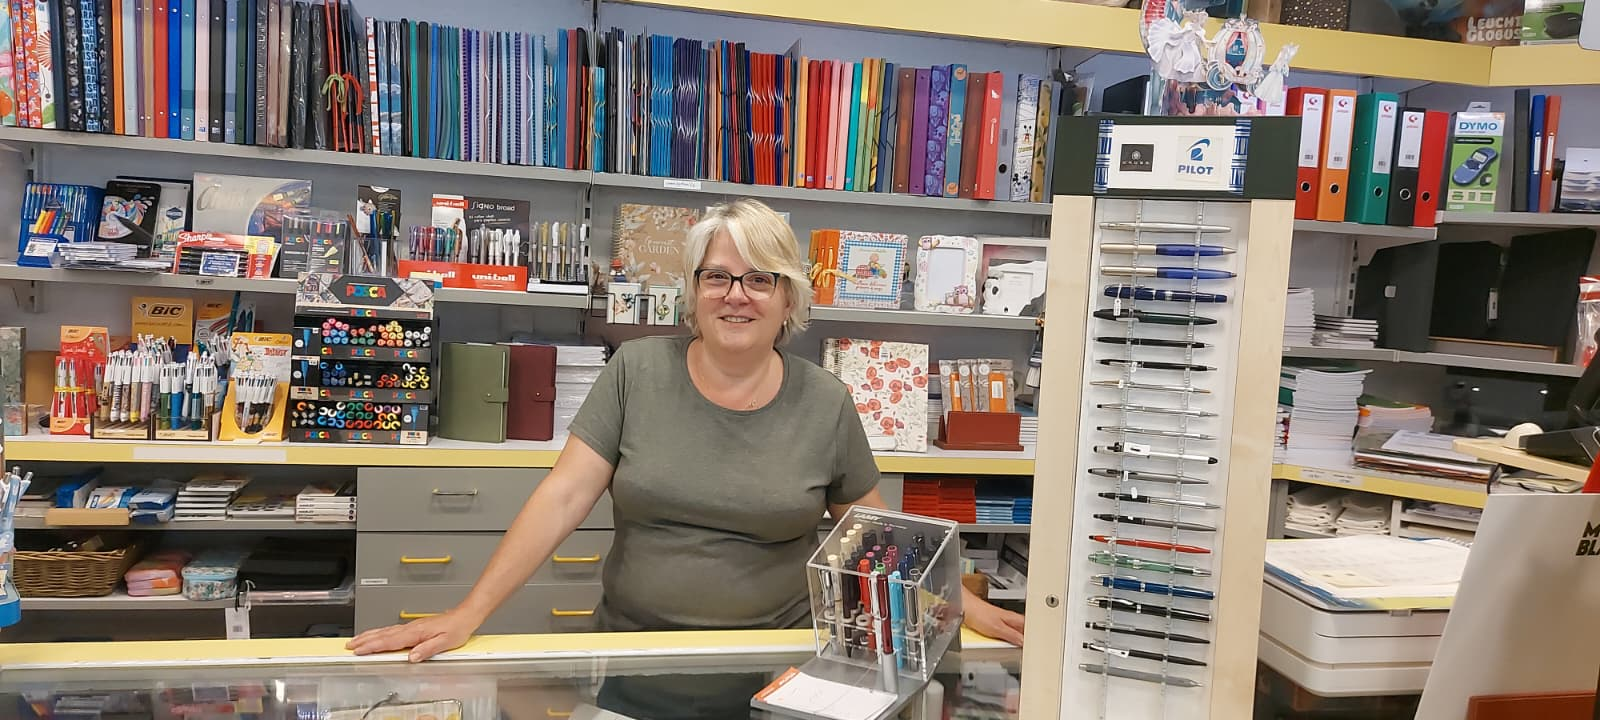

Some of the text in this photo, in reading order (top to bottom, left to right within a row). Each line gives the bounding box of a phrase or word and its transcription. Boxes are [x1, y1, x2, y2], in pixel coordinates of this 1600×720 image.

[1467, 16, 1520, 31] LEUCHT
[1466, 28, 1520, 42] GLOBUS
[1459, 121, 1498, 131] DYMO
[1177, 164, 1214, 175] PILOT
[346, 284, 387, 298] POSCA
[151, 306, 182, 316] BIC
[1575, 539, 1600, 556] BL
